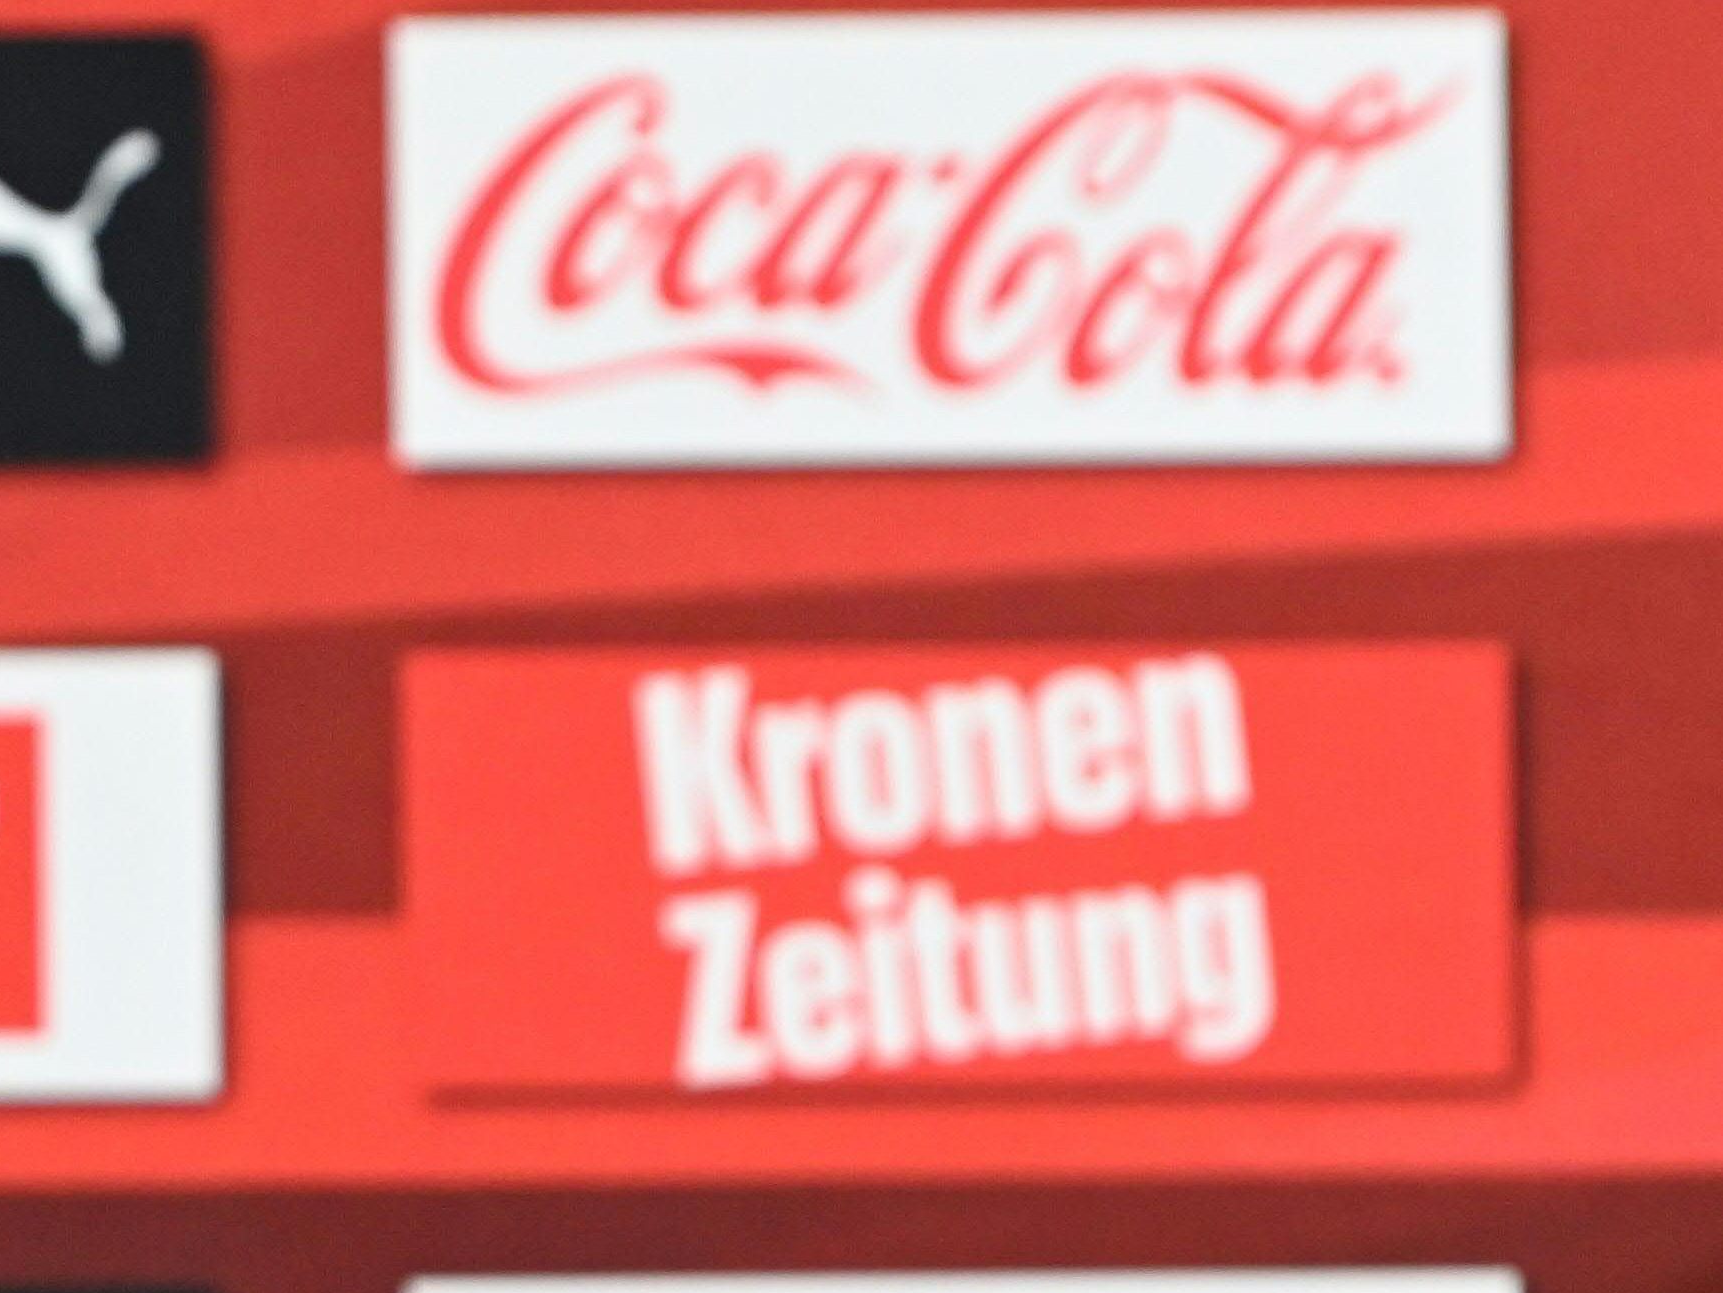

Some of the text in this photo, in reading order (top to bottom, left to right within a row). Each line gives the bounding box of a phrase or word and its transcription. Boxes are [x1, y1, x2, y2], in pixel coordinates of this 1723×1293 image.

[428, 68, 1473, 395] Coca-Cola
[633, 652, 1253, 878] Kronen
[661, 868, 1277, 1092] Zeitung
